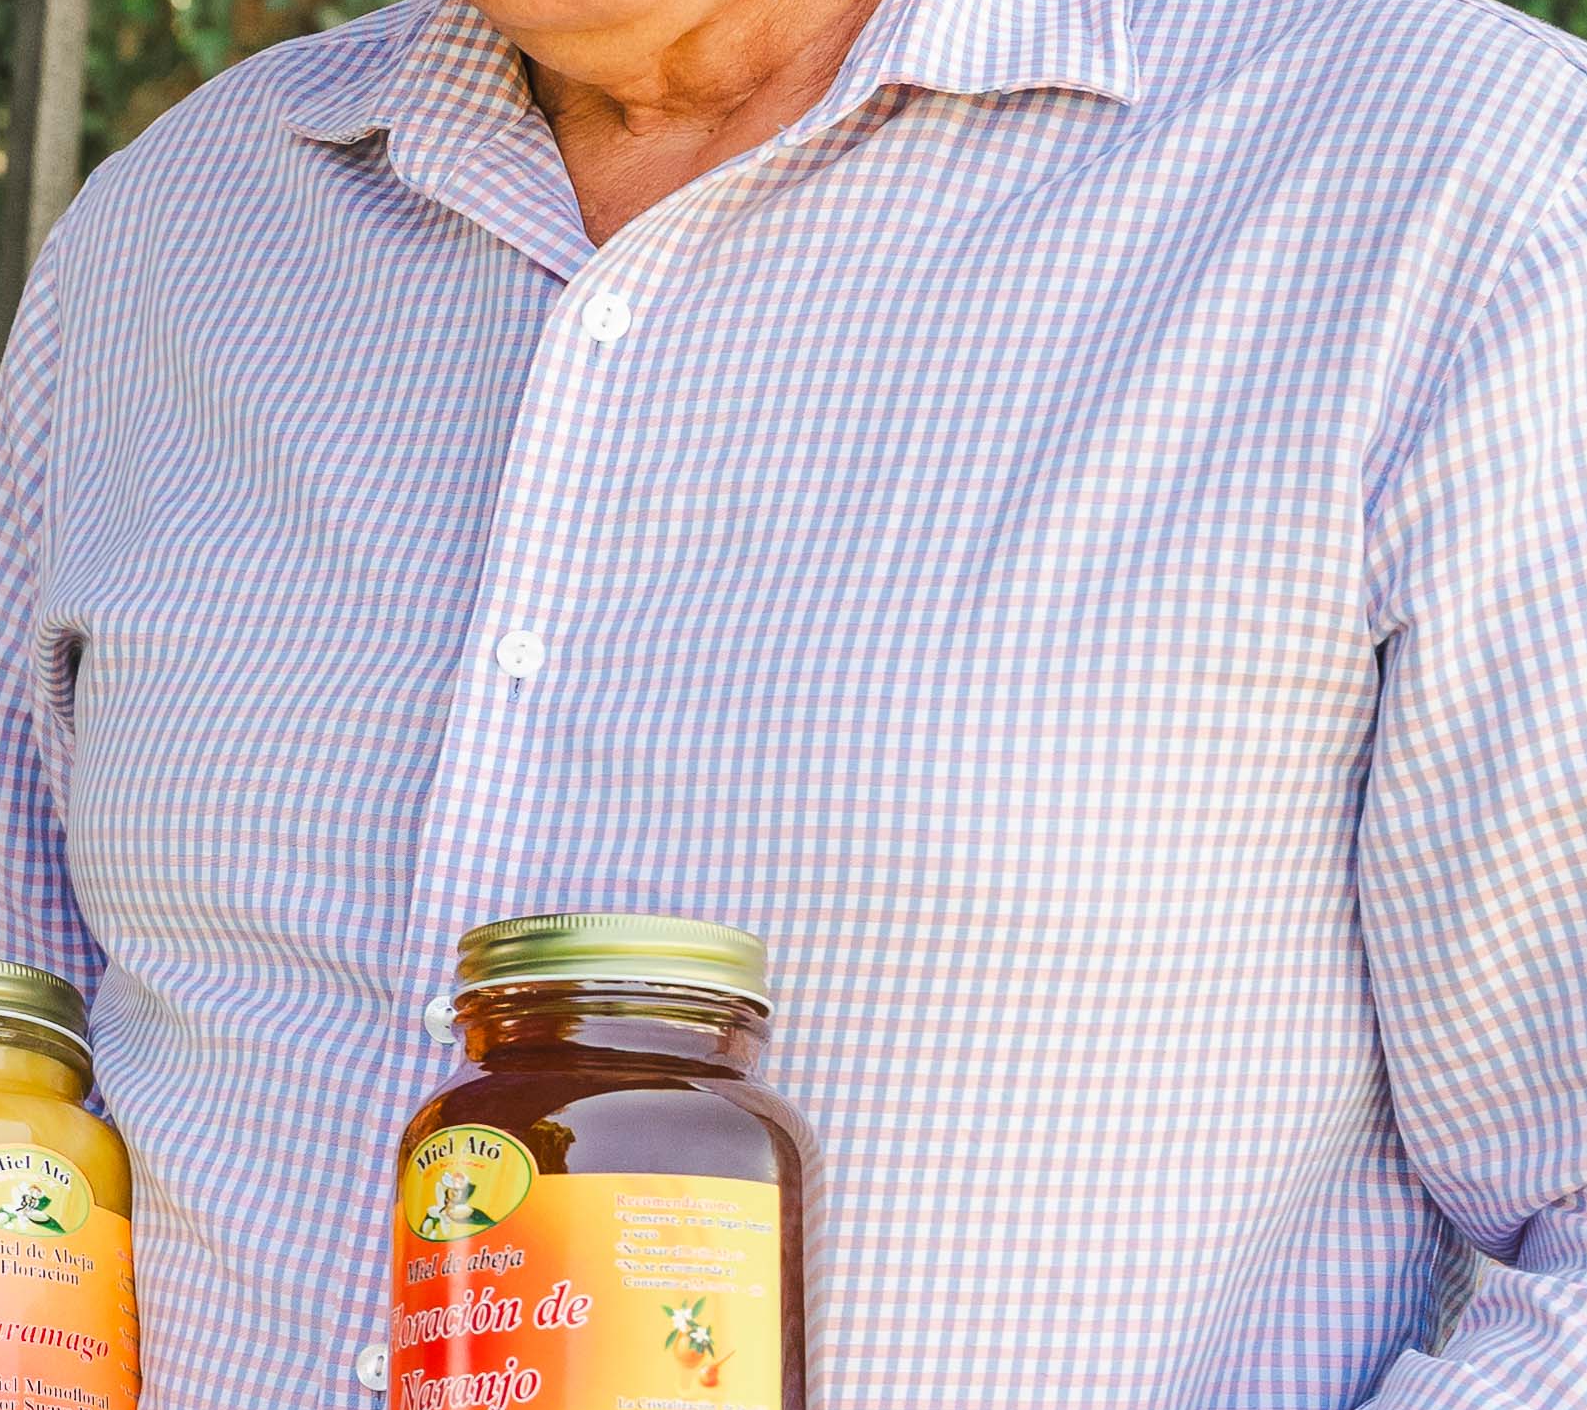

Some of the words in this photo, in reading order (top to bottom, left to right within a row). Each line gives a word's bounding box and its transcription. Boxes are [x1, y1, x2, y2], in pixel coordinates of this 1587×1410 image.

[416, 1136, 455, 1175] Miel
[463, 1135, 502, 1161] Ató
[40, 1160, 72, 1187] Ató
[26, 1241, 46, 1260] de
[52, 1247, 96, 1273] Abeja
[406, 1260, 439, 1286] Miel
[467, 1246, 524, 1278] abeja
[533, 1279, 593, 1330] de
[23, 1377, 111, 1410] Monofloral
